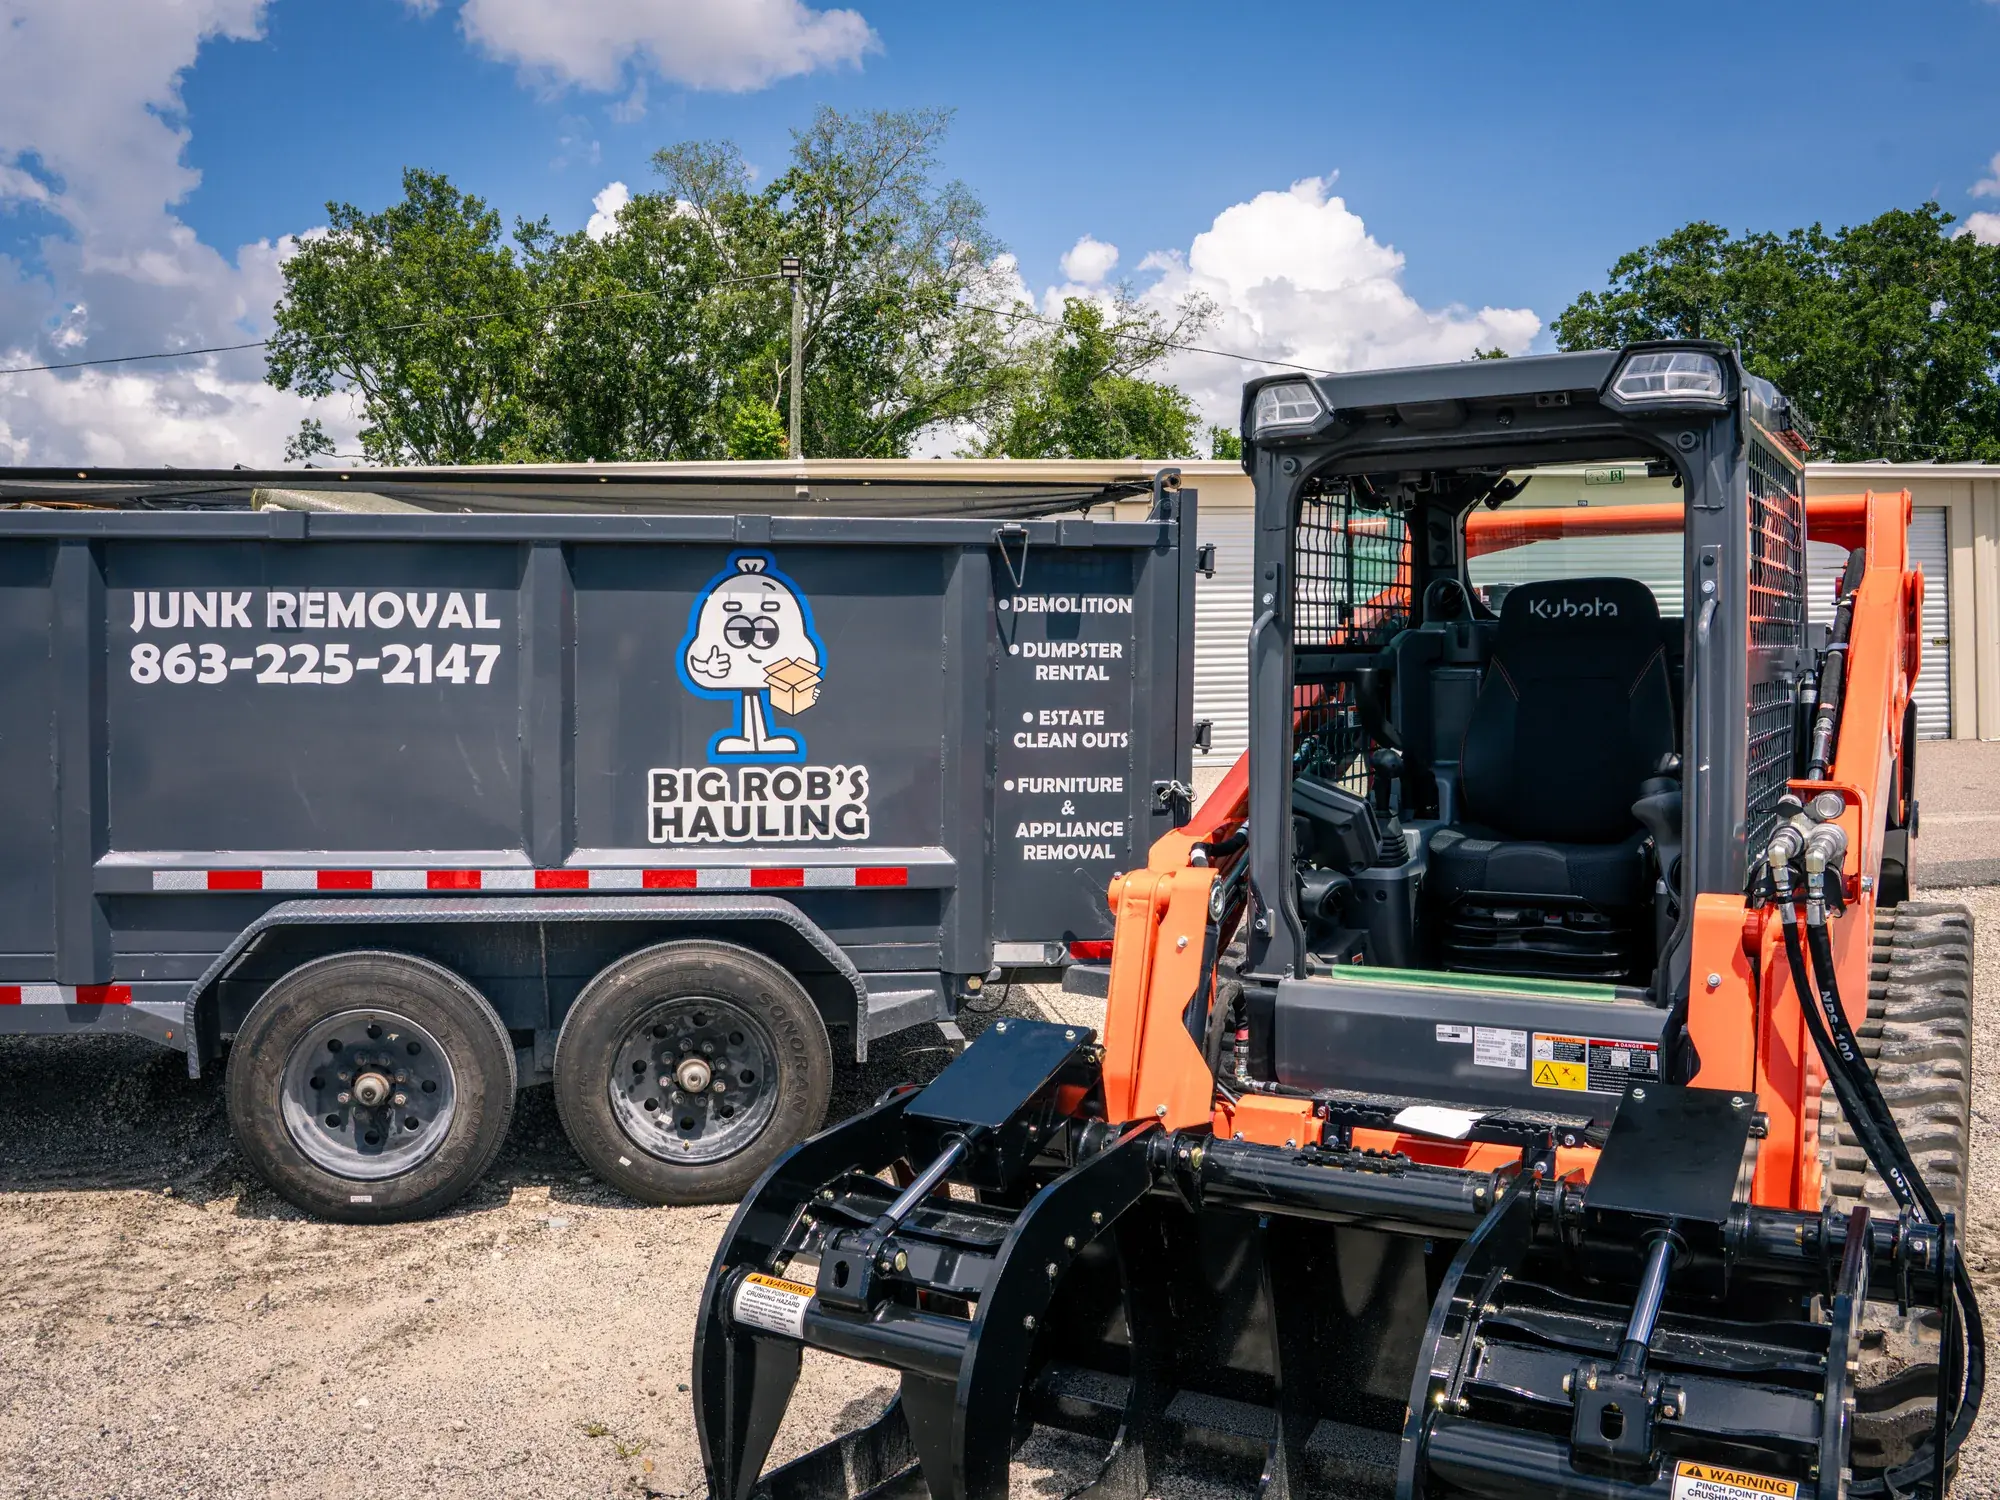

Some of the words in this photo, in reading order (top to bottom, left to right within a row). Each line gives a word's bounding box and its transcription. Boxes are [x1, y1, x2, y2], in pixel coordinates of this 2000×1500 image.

[130, 591, 252, 633] JUNK
[267, 591, 501, 629] REMOVAL
[1013, 597, 1132, 613] DEMOLITION
[1529, 597, 1618, 619] Kubota
[1023, 642, 1122, 658] DUMPSTER
[130, 643, 501, 684] 863-225-2147
[1036, 665, 1110, 681] RENTAL
[1039, 710, 1105, 726] ESTATE
[1014, 732, 1077, 748] CLEAN
[1082, 732, 1128, 748] OUTS
[653, 771, 726, 803] BIG
[743, 769, 865, 802] ROB'S
[1018, 777, 1123, 793] FURNITURE
[1061, 800, 1075, 815] &
[653, 803, 866, 838] HAULING
[1015, 821, 1124, 838] APPLIANCE
[1023, 844, 1116, 860] REMOVAL
[758, 992, 811, 1116] SONORAN
[753, 1285, 771, 1294] PINCH
[771, 1289, 789, 1298] POINT
[789, 1293, 799, 1301] OR
[765, 1278, 812, 1295] WARNING
[746, 1290, 776, 1302] CRUSHING
[776, 1297, 800, 1308] HAZARD
[1710, 1469, 1788, 1494] WARNING
[1695, 1481, 1726, 1494] PINCH
[1728, 1486, 1759, 1500] POINT
